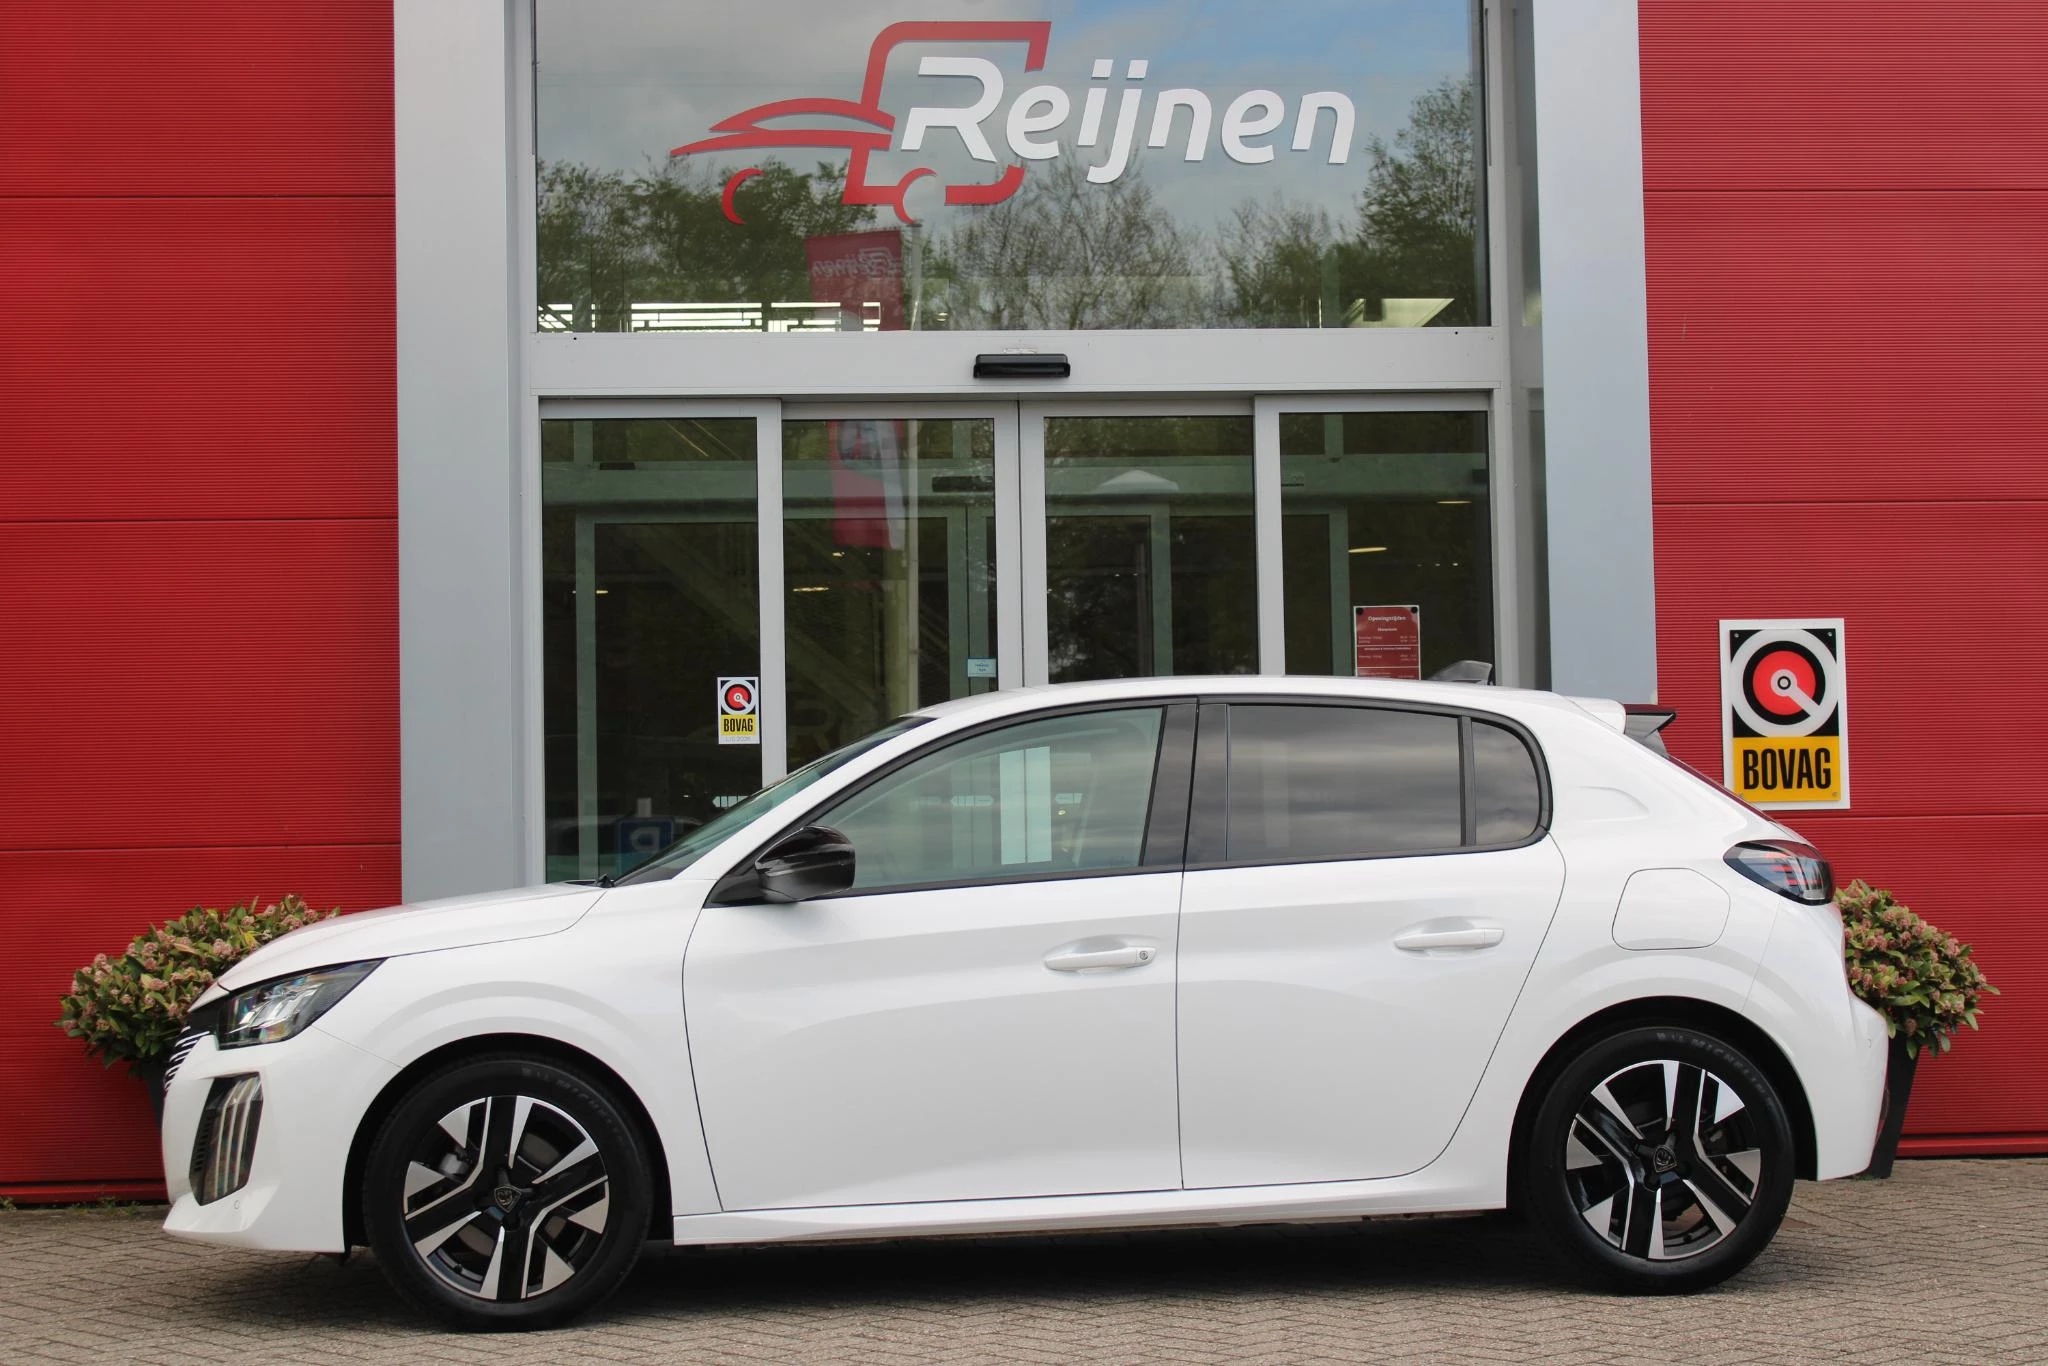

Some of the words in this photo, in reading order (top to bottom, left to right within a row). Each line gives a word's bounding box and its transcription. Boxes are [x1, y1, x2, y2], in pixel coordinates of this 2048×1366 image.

[901, 57, 1356, 184] Reijnen
[723, 718, 753, 732] BOVAG
[1743, 748, 1831, 790] BOVAG
